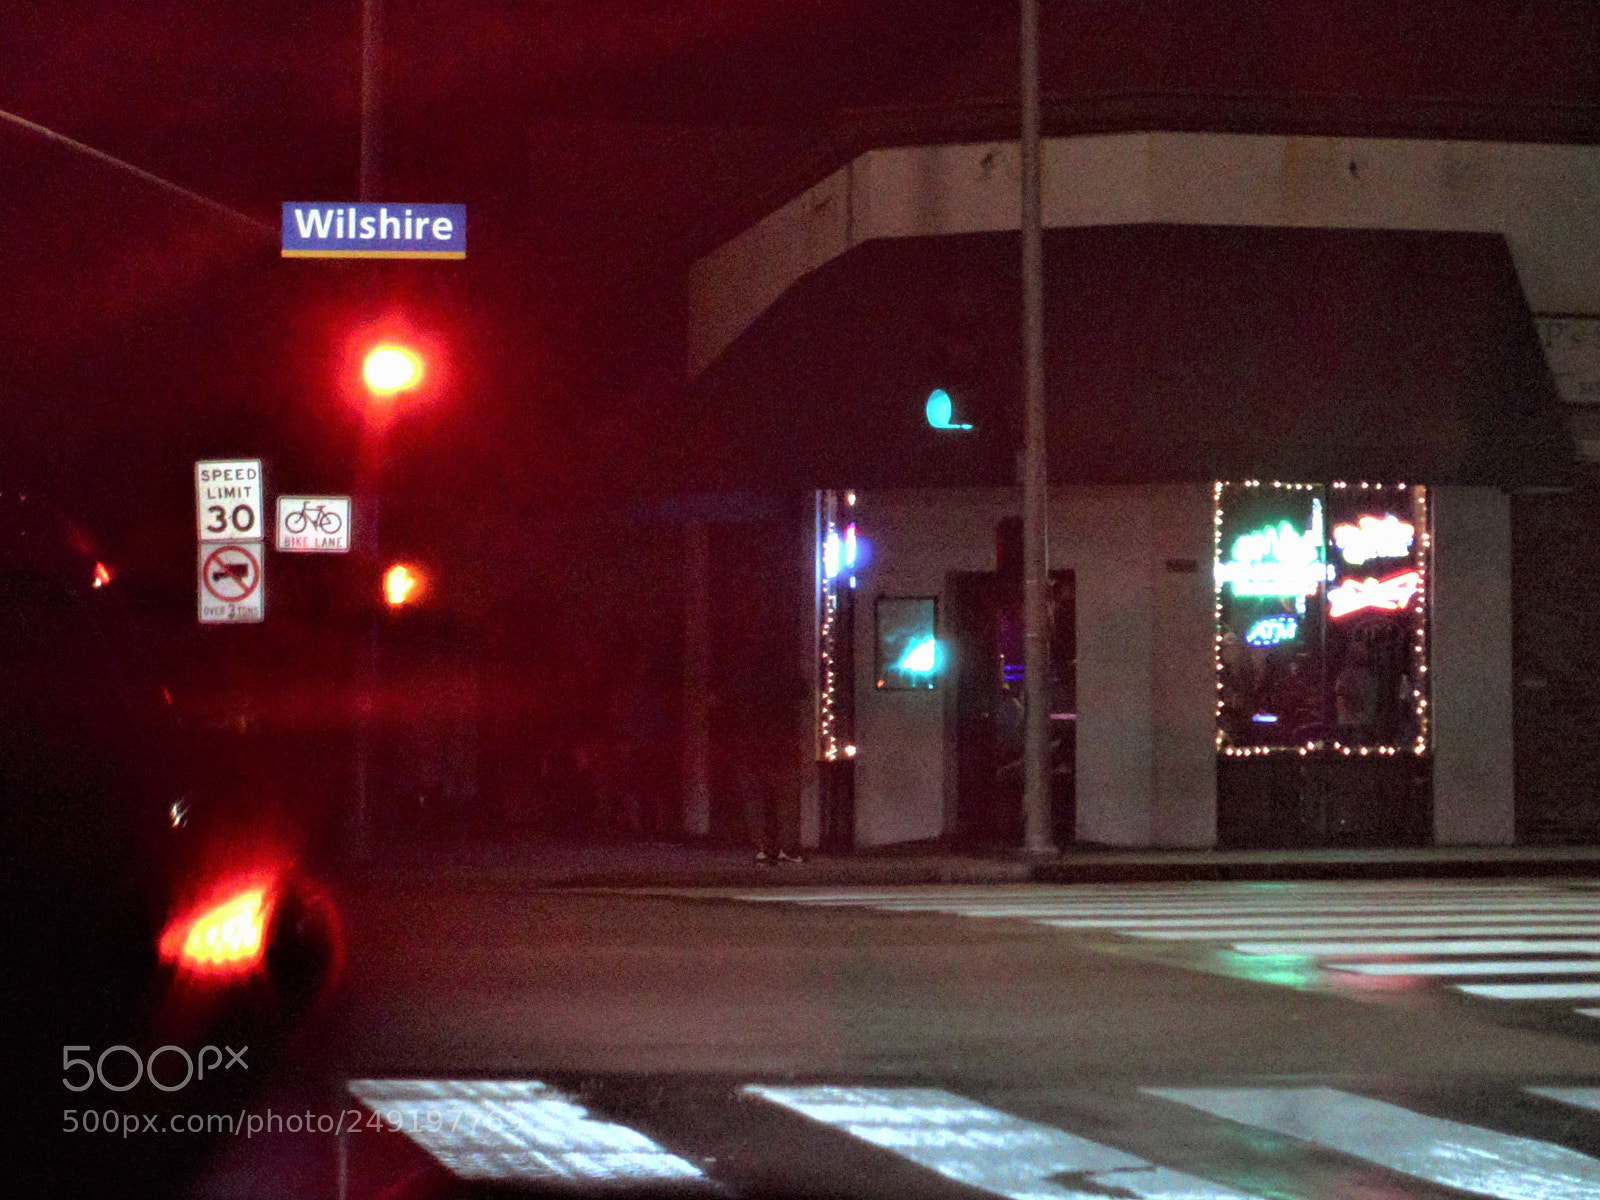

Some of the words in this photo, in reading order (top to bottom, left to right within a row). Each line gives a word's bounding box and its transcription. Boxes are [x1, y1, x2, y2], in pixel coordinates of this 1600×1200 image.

[294, 207, 453, 240] Wilshire
[201, 468, 257, 482] SPEED
[207, 486, 252, 500] LIMIT
[206, 503, 255, 533] 30
[284, 536, 308, 548] BIKE
[314, 536, 342, 548] LANE
[1249, 619, 1297, 641] ATM
